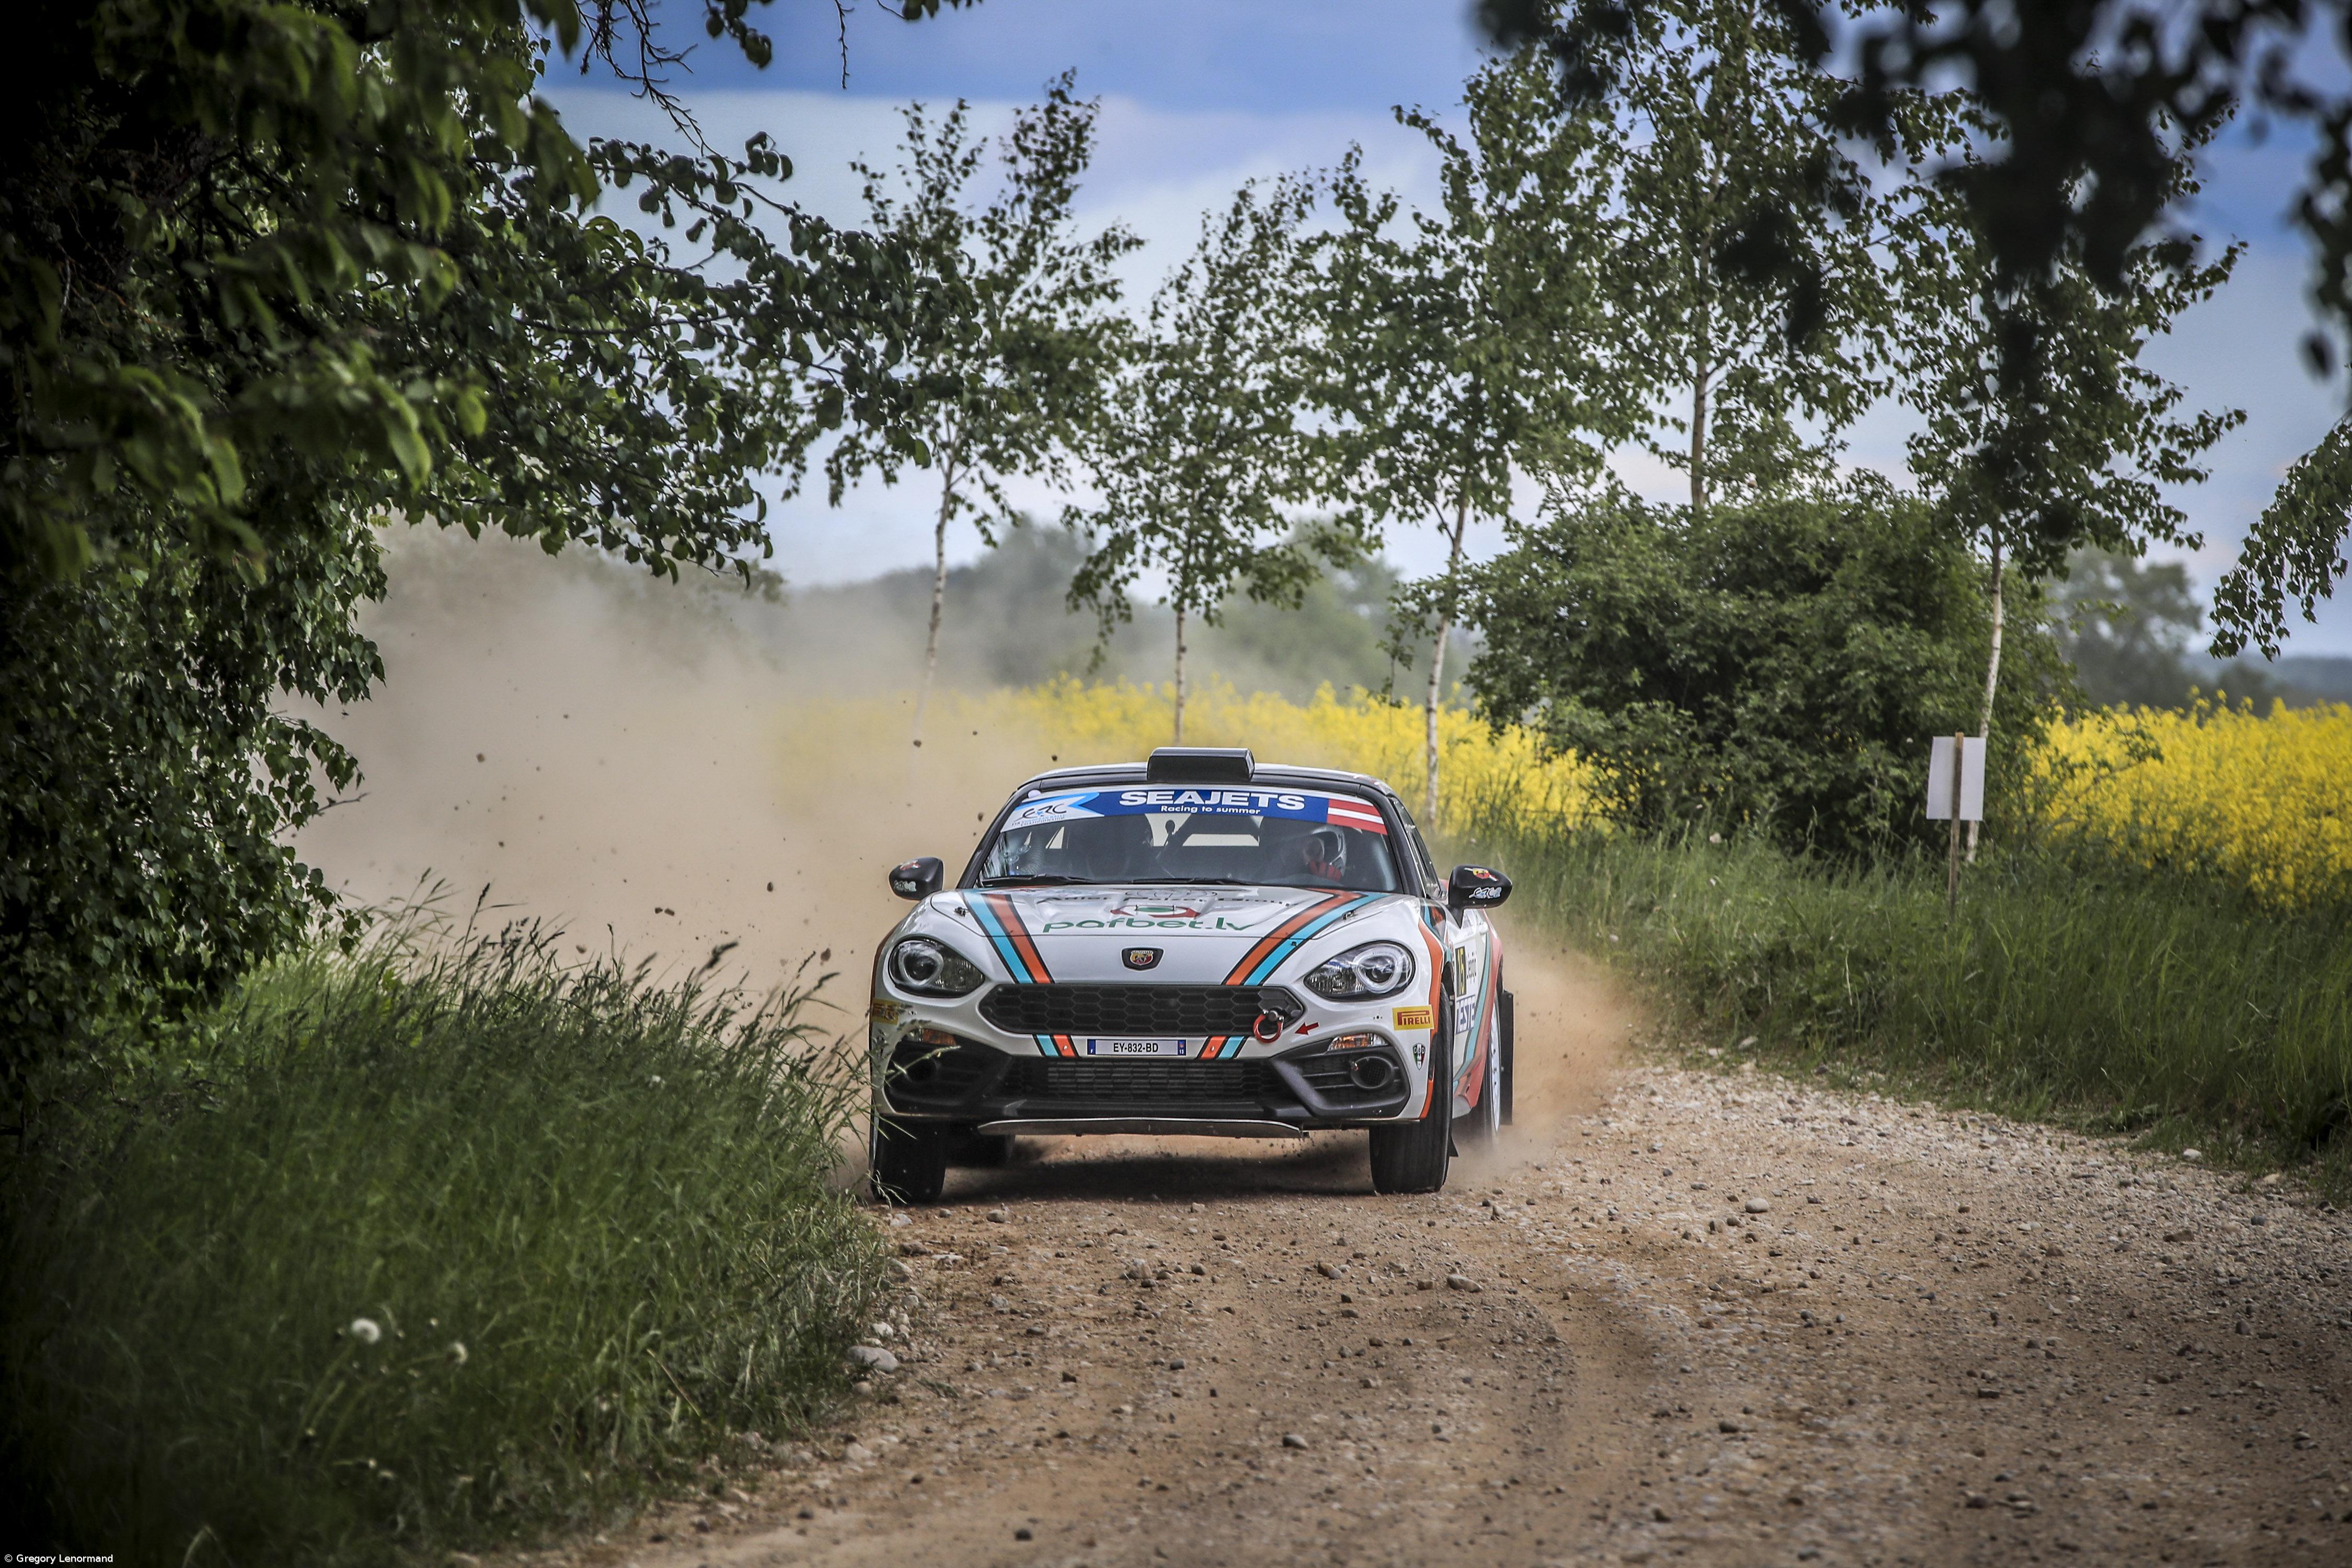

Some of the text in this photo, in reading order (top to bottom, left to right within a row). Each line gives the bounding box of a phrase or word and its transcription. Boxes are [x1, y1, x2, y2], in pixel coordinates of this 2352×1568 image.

[1119, 791, 1305, 811] SEAJETS
[1161, 805, 1198, 813] Racing
[1457, 948, 1465, 995] 15
[1397, 1010, 1430, 1025] PIRELLI
[1113, 1043, 1159, 1053] EY-832-BD
